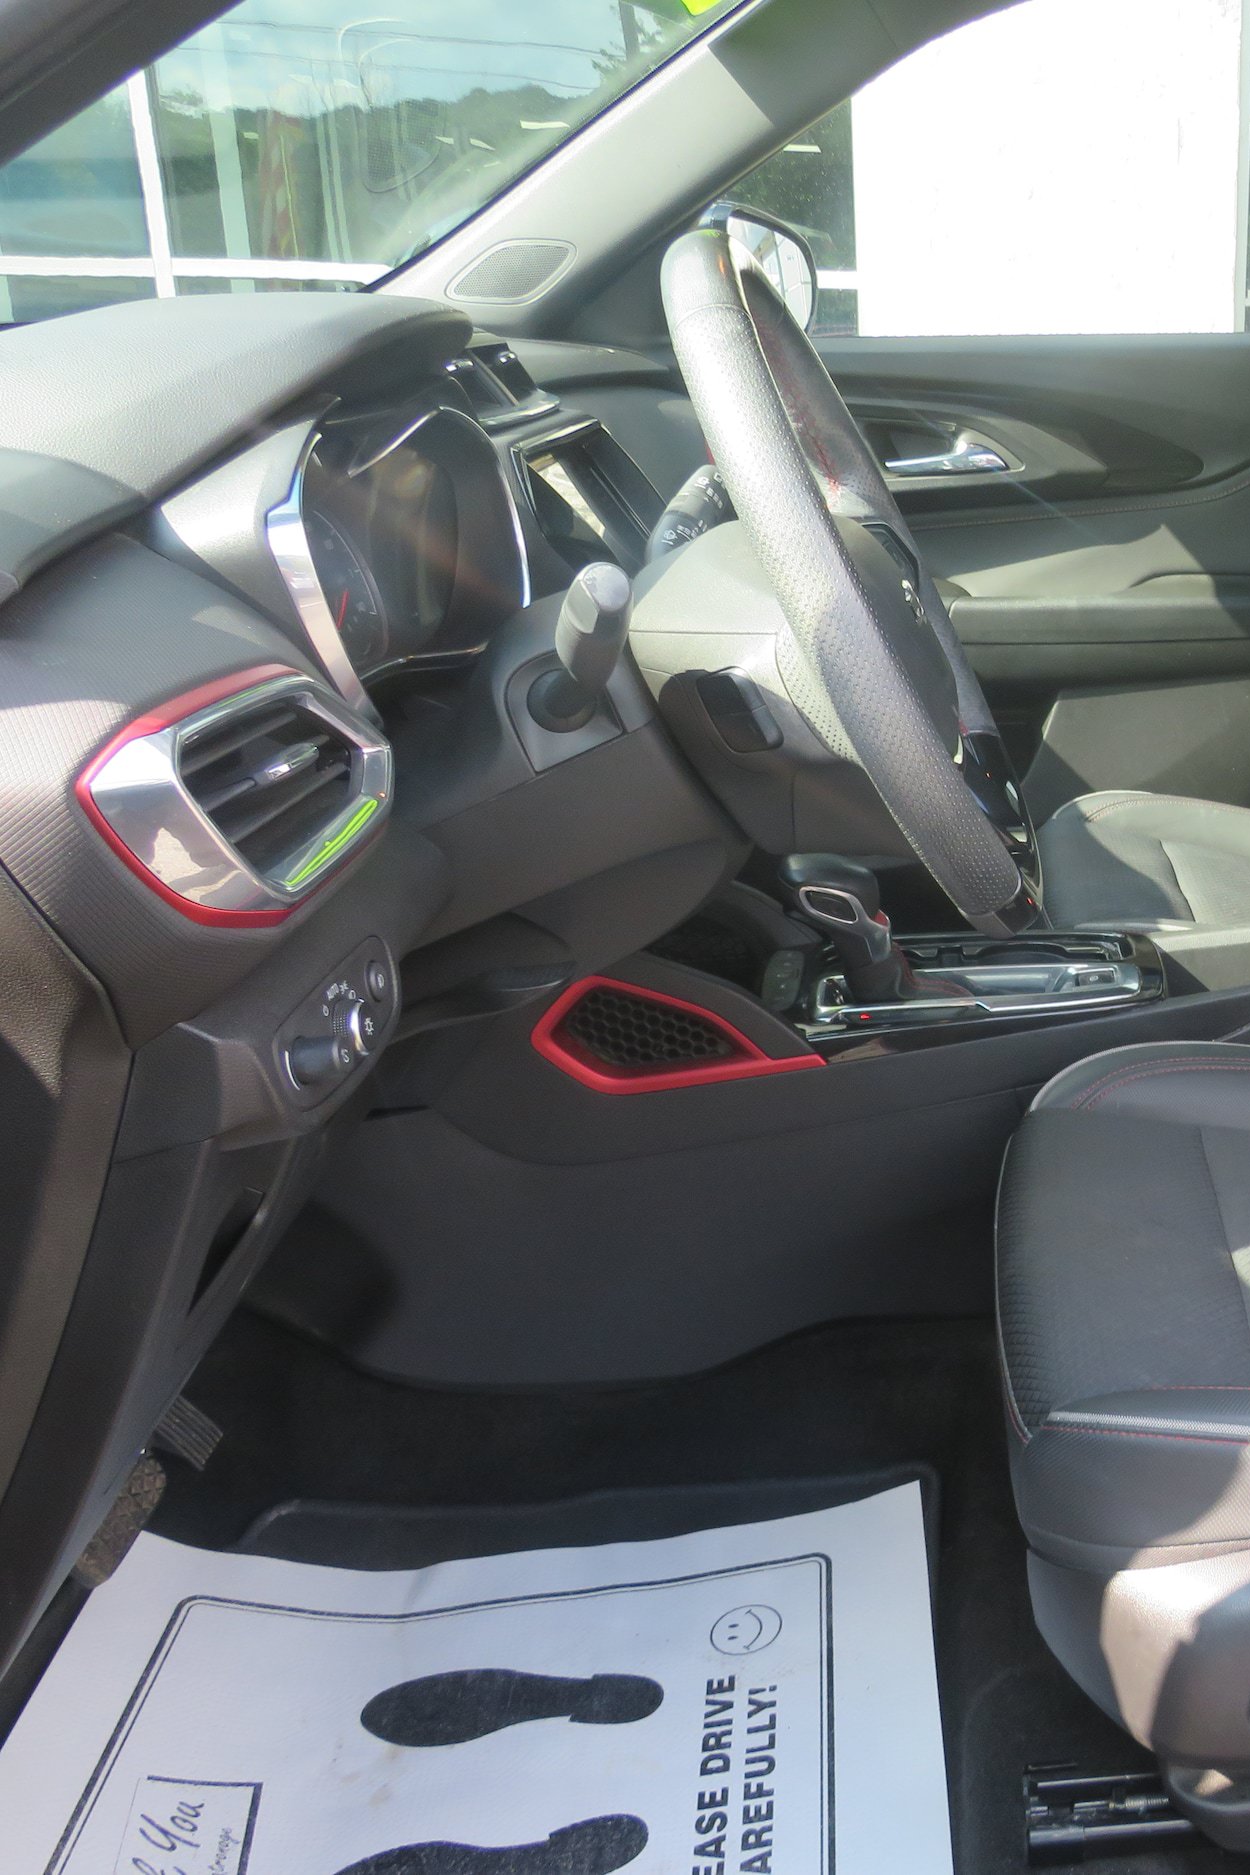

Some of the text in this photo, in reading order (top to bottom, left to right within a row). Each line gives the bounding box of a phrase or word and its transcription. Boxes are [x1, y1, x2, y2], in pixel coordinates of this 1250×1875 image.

[700, 1675, 736, 1777] DRIVE
[140, 1801, 205, 1851] You
[740, 1685, 777, 1874] AREFULLY!
